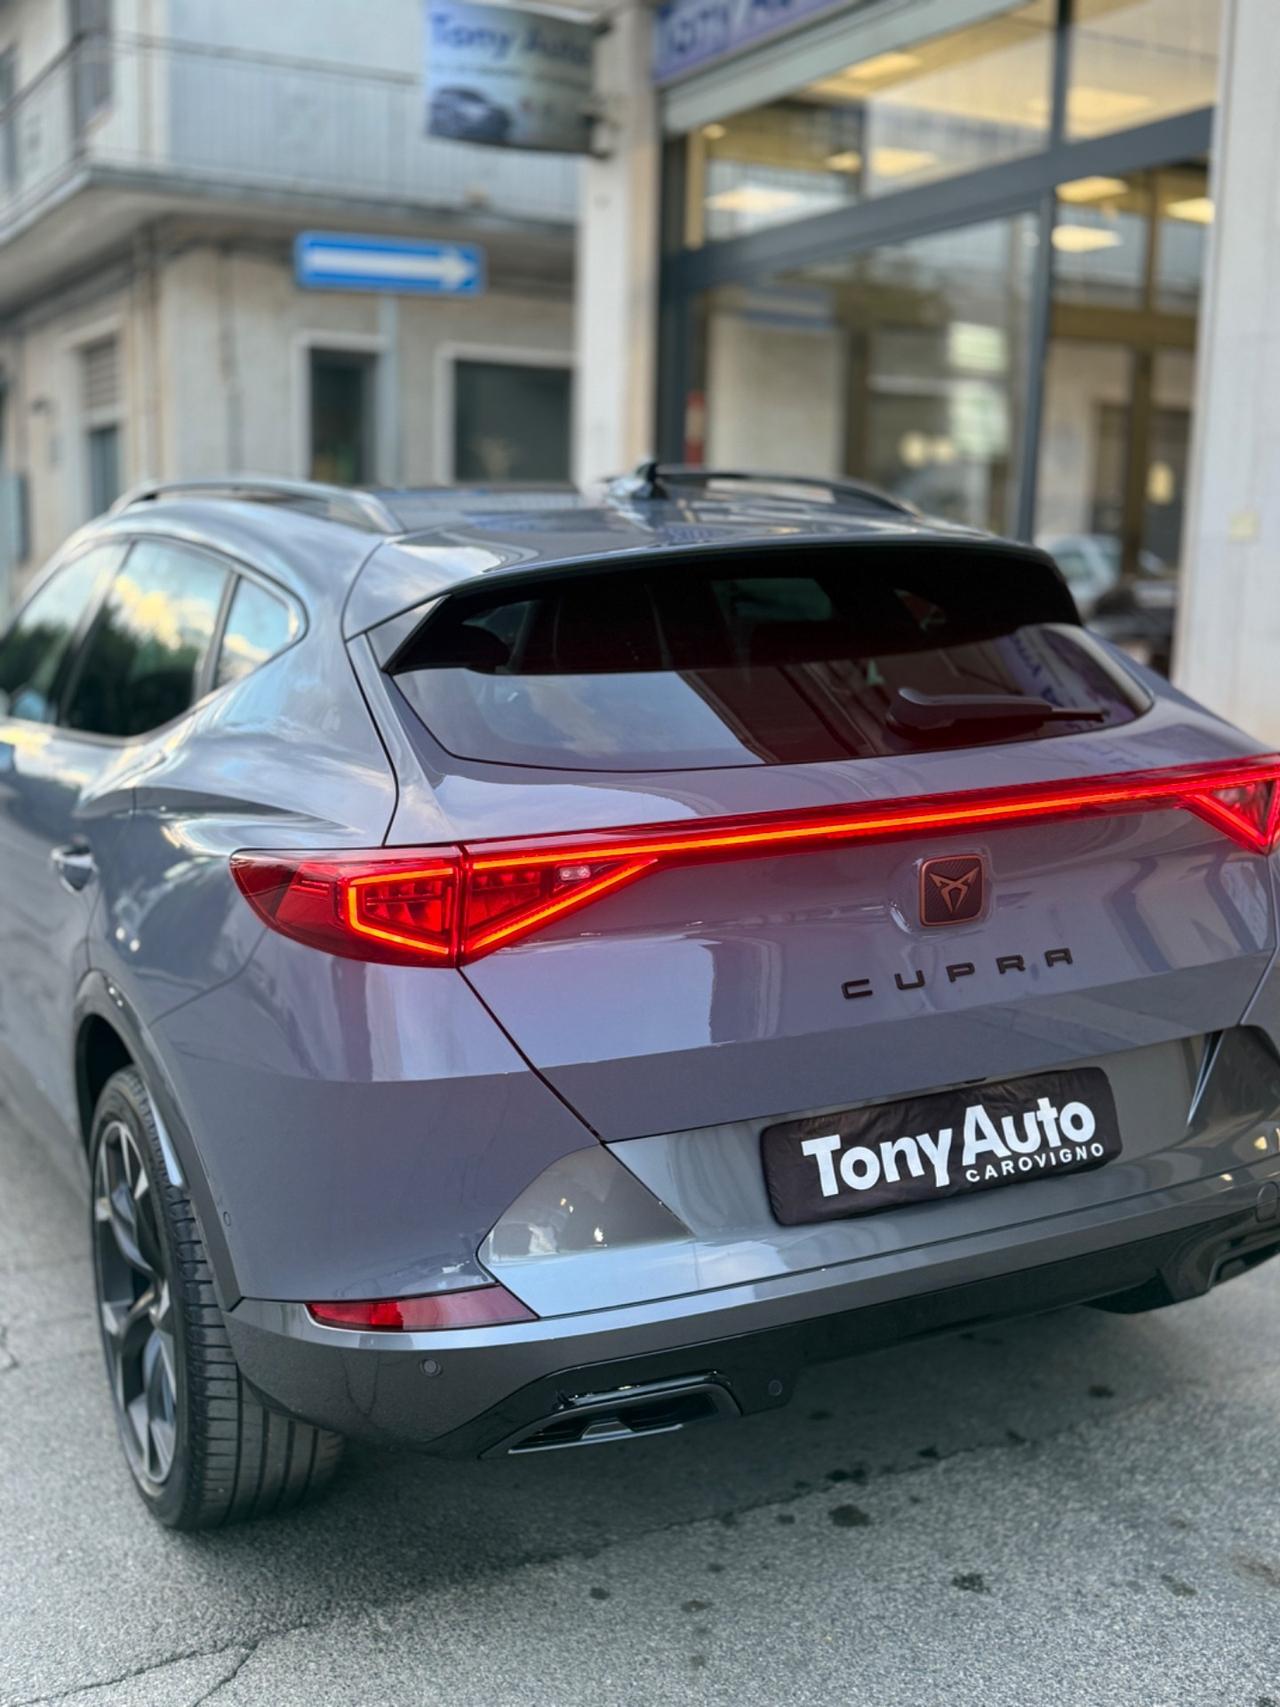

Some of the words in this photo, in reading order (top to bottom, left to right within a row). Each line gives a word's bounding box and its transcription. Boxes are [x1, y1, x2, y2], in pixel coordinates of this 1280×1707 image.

[841, 948, 1073, 1000] CUPRA
[801, 1128, 952, 1197] Tony
[962, 1097, 1096, 1166] Auto
[966, 1143, 1104, 1182] CAROVIGNO
